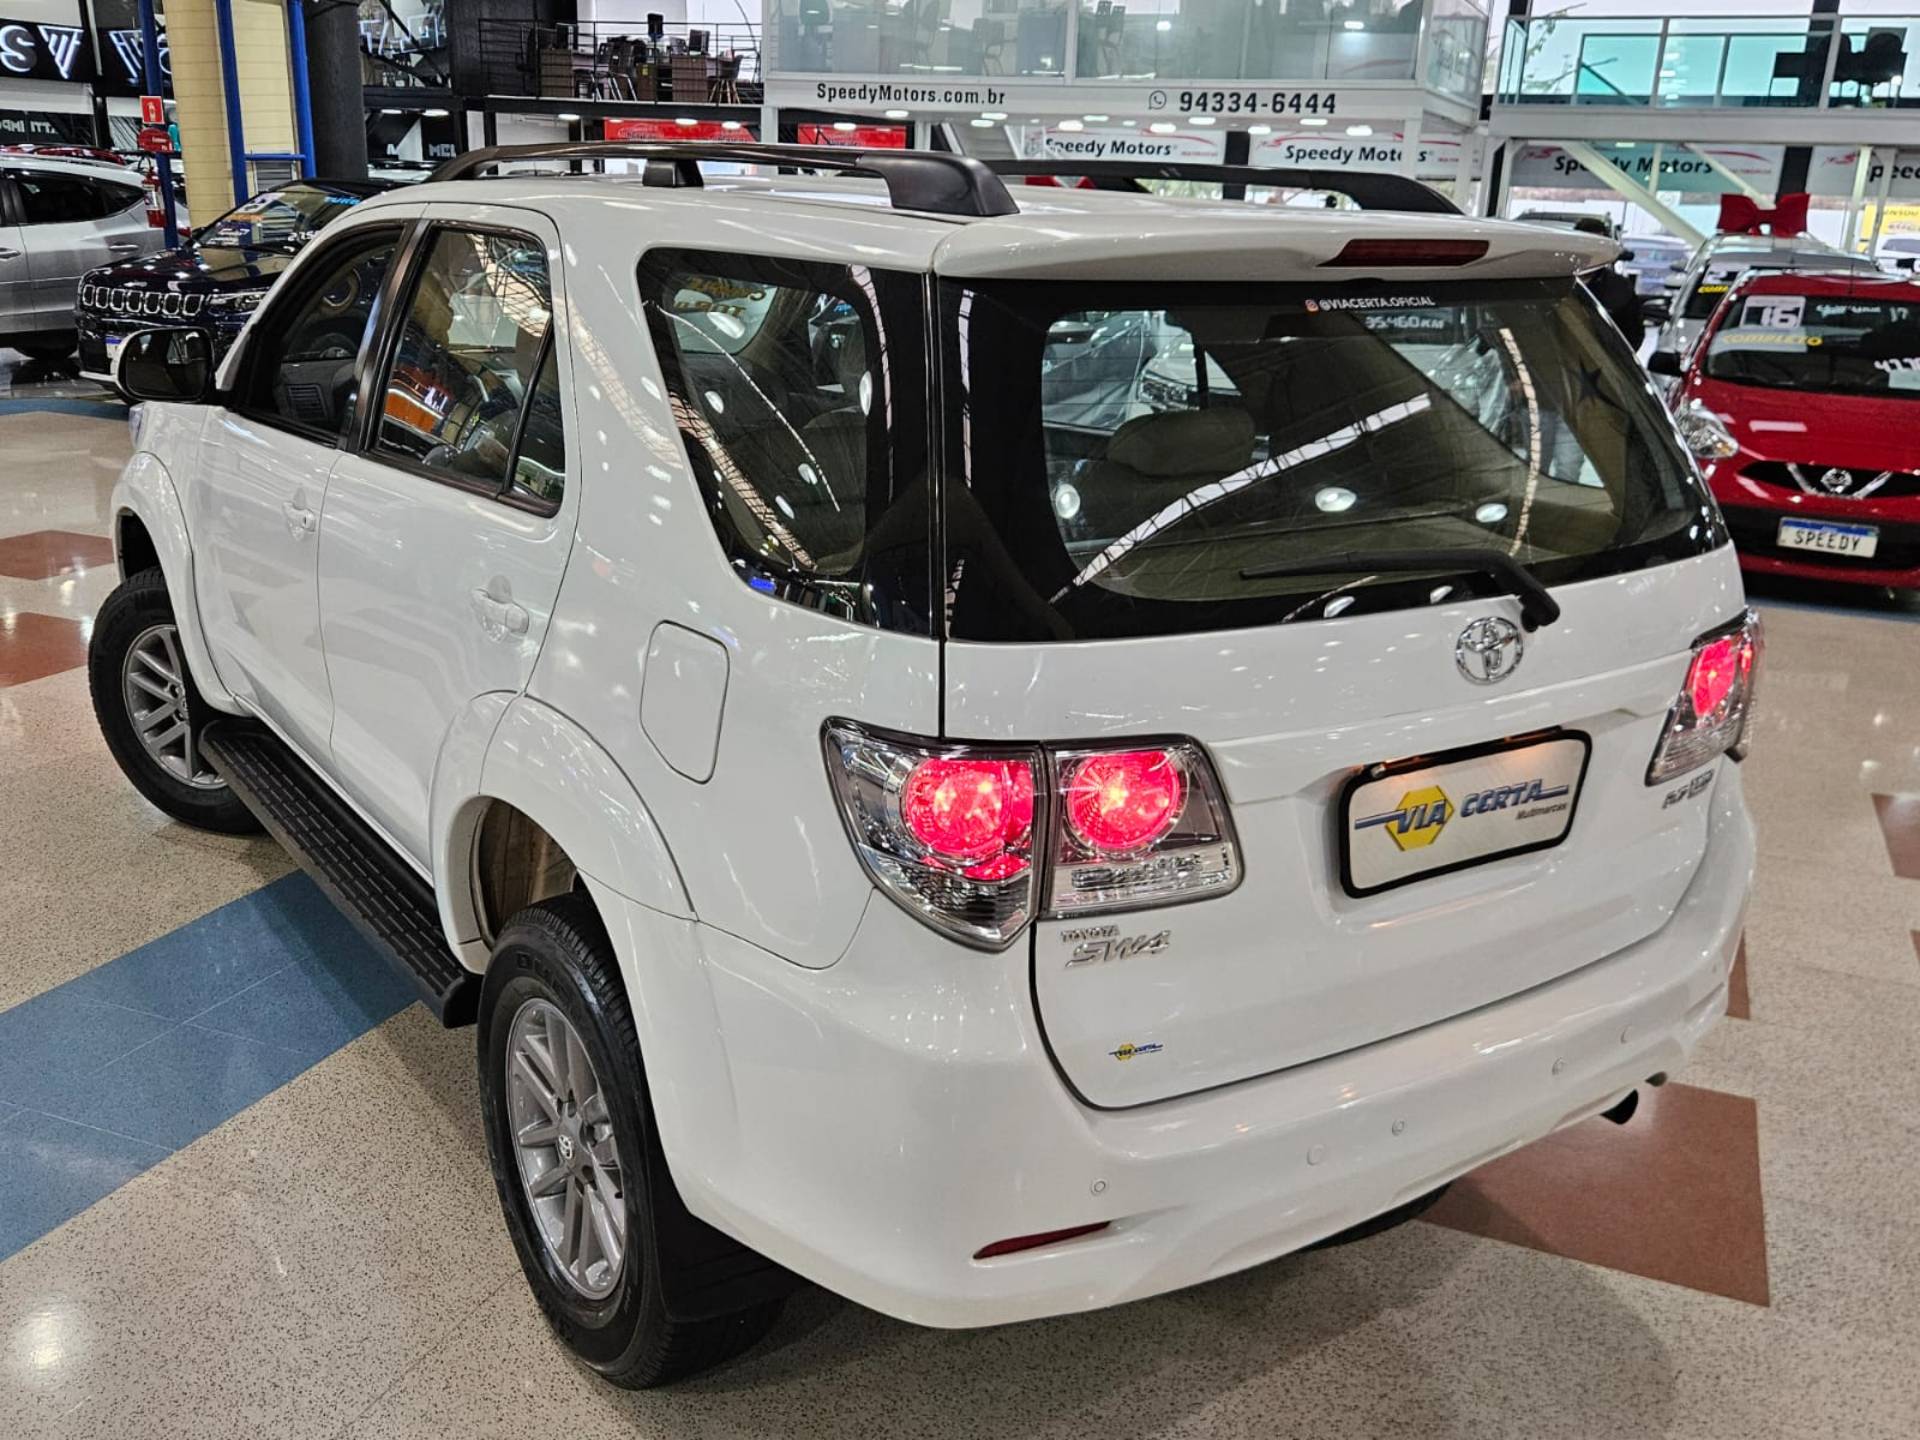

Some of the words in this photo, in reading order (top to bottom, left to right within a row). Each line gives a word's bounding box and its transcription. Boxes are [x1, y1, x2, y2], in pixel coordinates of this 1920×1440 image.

[816, 82, 1006, 105] SpeedyMotors.com.br
[1179, 91, 1336, 114] 94334-6444
[1046, 138, 1106, 157] Speedy
[1110, 140, 1173, 156] Motors
[1285, 145, 1354, 165] Speedy
[1358, 147, 1428, 162] Mots
[1554, 154, 1632, 175] Spedy
[1319, 296, 1436, 311] @VIACERTA.OFICIAL
[1794, 530, 1861, 551] SPEEDY
[1397, 800, 1447, 834] VIA
[1460, 778, 1543, 818] CERTA
[1061, 925, 1119, 942] TOYOTA
